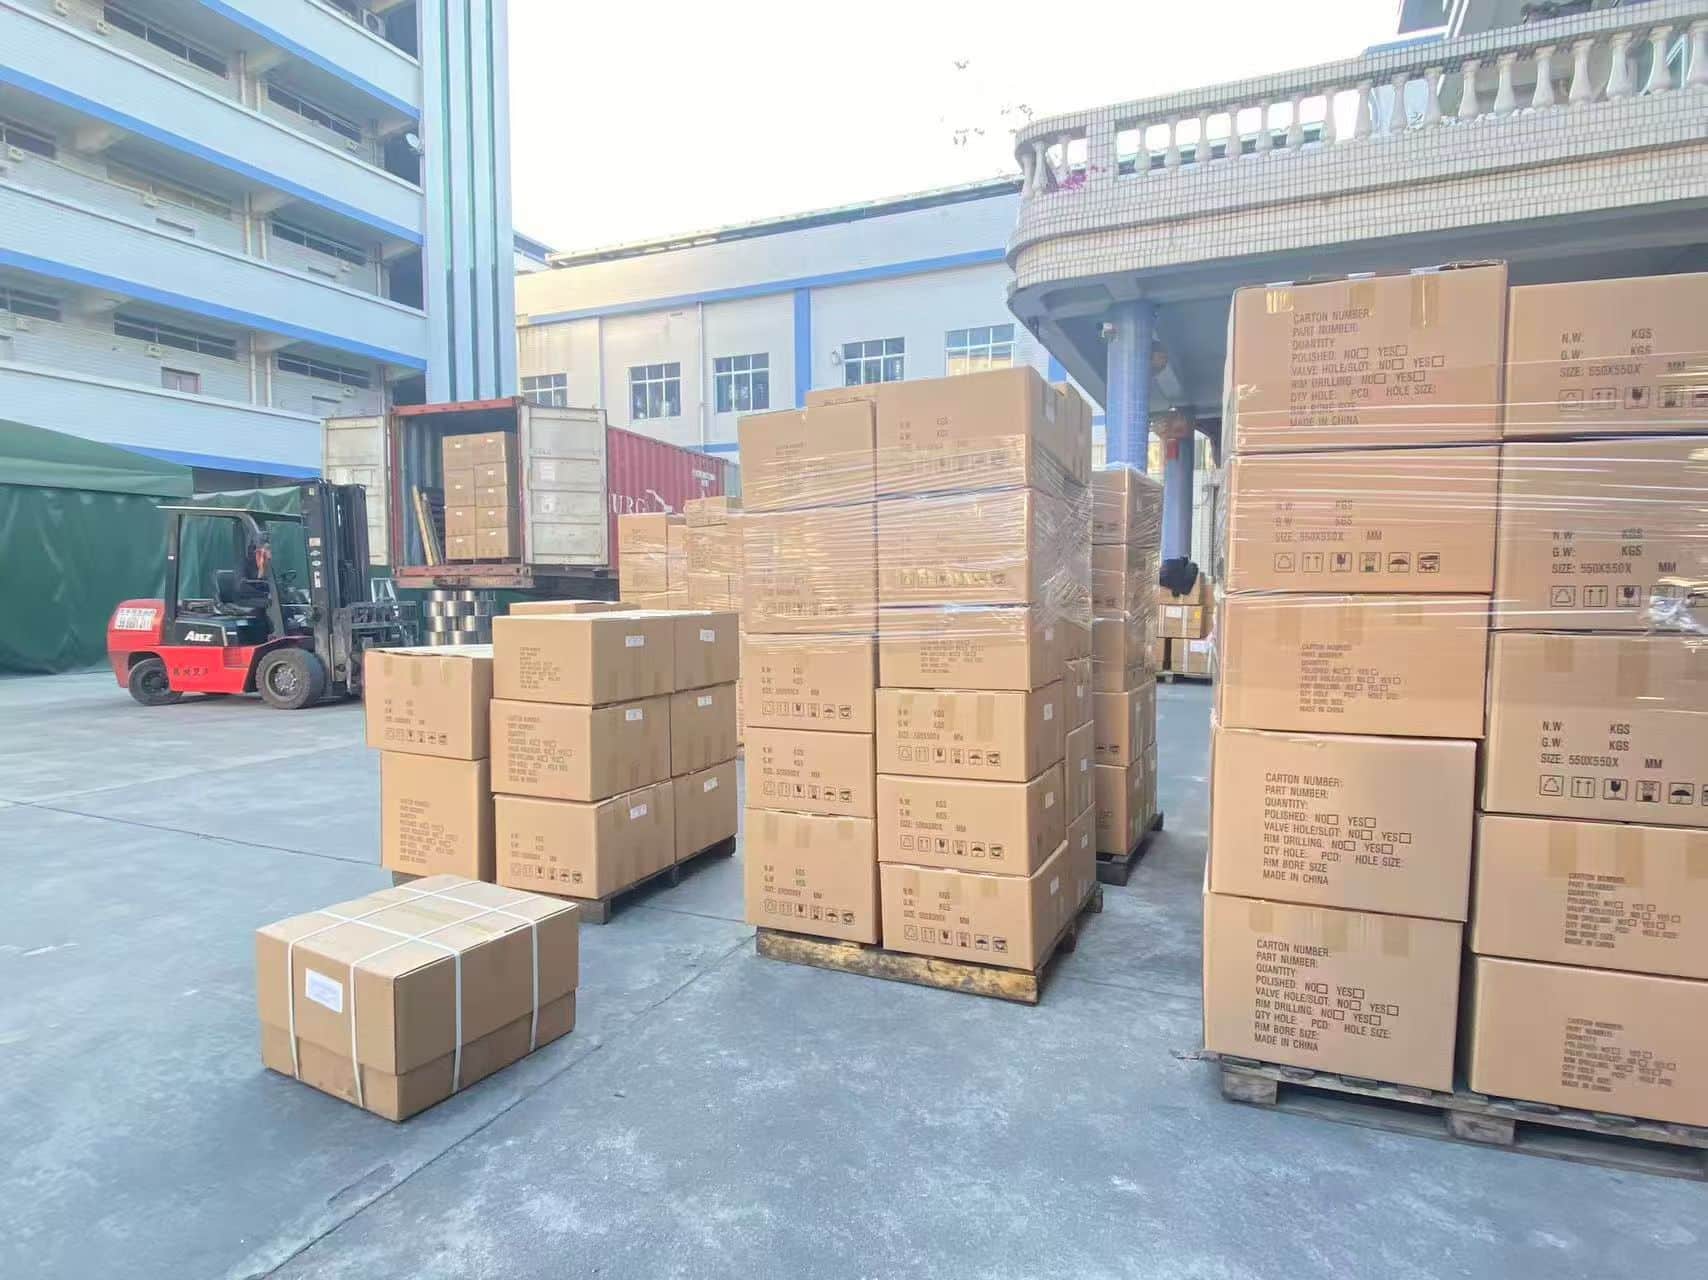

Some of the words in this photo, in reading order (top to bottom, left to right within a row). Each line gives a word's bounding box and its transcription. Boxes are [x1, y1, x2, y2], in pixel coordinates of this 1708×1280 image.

[1293, 312, 1328, 324] CARTON
[1631, 328, 1652, 339] KGS
[1291, 366, 1317, 376] VALVE
[1414, 356, 1430, 368] YES
[1386, 385, 1409, 397] HOLE
[1332, 414, 1359, 425] CHINA
[1621, 545, 1642, 556] KGS
[1658, 562, 1676, 573] MM
[1609, 723, 1631, 735] KGS
[1608, 740, 1630, 751] KGS
[1644, 758, 1663, 769] MM
[1265, 772, 1299, 785] CARTON
[1265, 785, 1286, 796] PART
[1314, 813, 1327, 824] NO
[1347, 816, 1364, 827] YES
[1264, 821, 1289, 833] VALVE
[1348, 829, 1361, 840] NO
[1381, 831, 1398, 842] YES
[1264, 833, 1280, 844] RIM
[1331, 840, 1344, 850] NO
[1365, 843, 1381, 854] YES
[1263, 845, 1280, 856] QTY
[1355, 855, 1379, 866] HOLE
[1263, 857, 1279, 868] RIM
[1282, 860, 1305, 871] BORE
[1263, 869, 1286, 881] MADE
[1290, 872, 1299, 882] IN
[1303, 873, 1329, 885] CHINA
[1256, 939, 1290, 952] CARTON
[1256, 951, 1276, 962] PART
[1305, 982, 1317, 992] NO
[1336, 986, 1353, 997] YES
[1255, 987, 1280, 998] VALVE
[1337, 999, 1350, 1009] NO
[1370, 1003, 1386, 1014] YES
[1255, 999, 1271, 1009] RIM
[1321, 1008, 1333, 1018] NO
[1354, 1013, 1369, 1024] YES
[1254, 1021, 1270, 1032] RIM
[1273, 1025, 1296, 1037] BORE
[1255, 1010, 1271, 1020] QTY
[1344, 1023, 1366, 1036] HOLE
[1254, 1033, 1277, 1046] MADE
[1281, 1037, 1290, 1047] IN
[1293, 1040, 1319, 1052] CHINA
